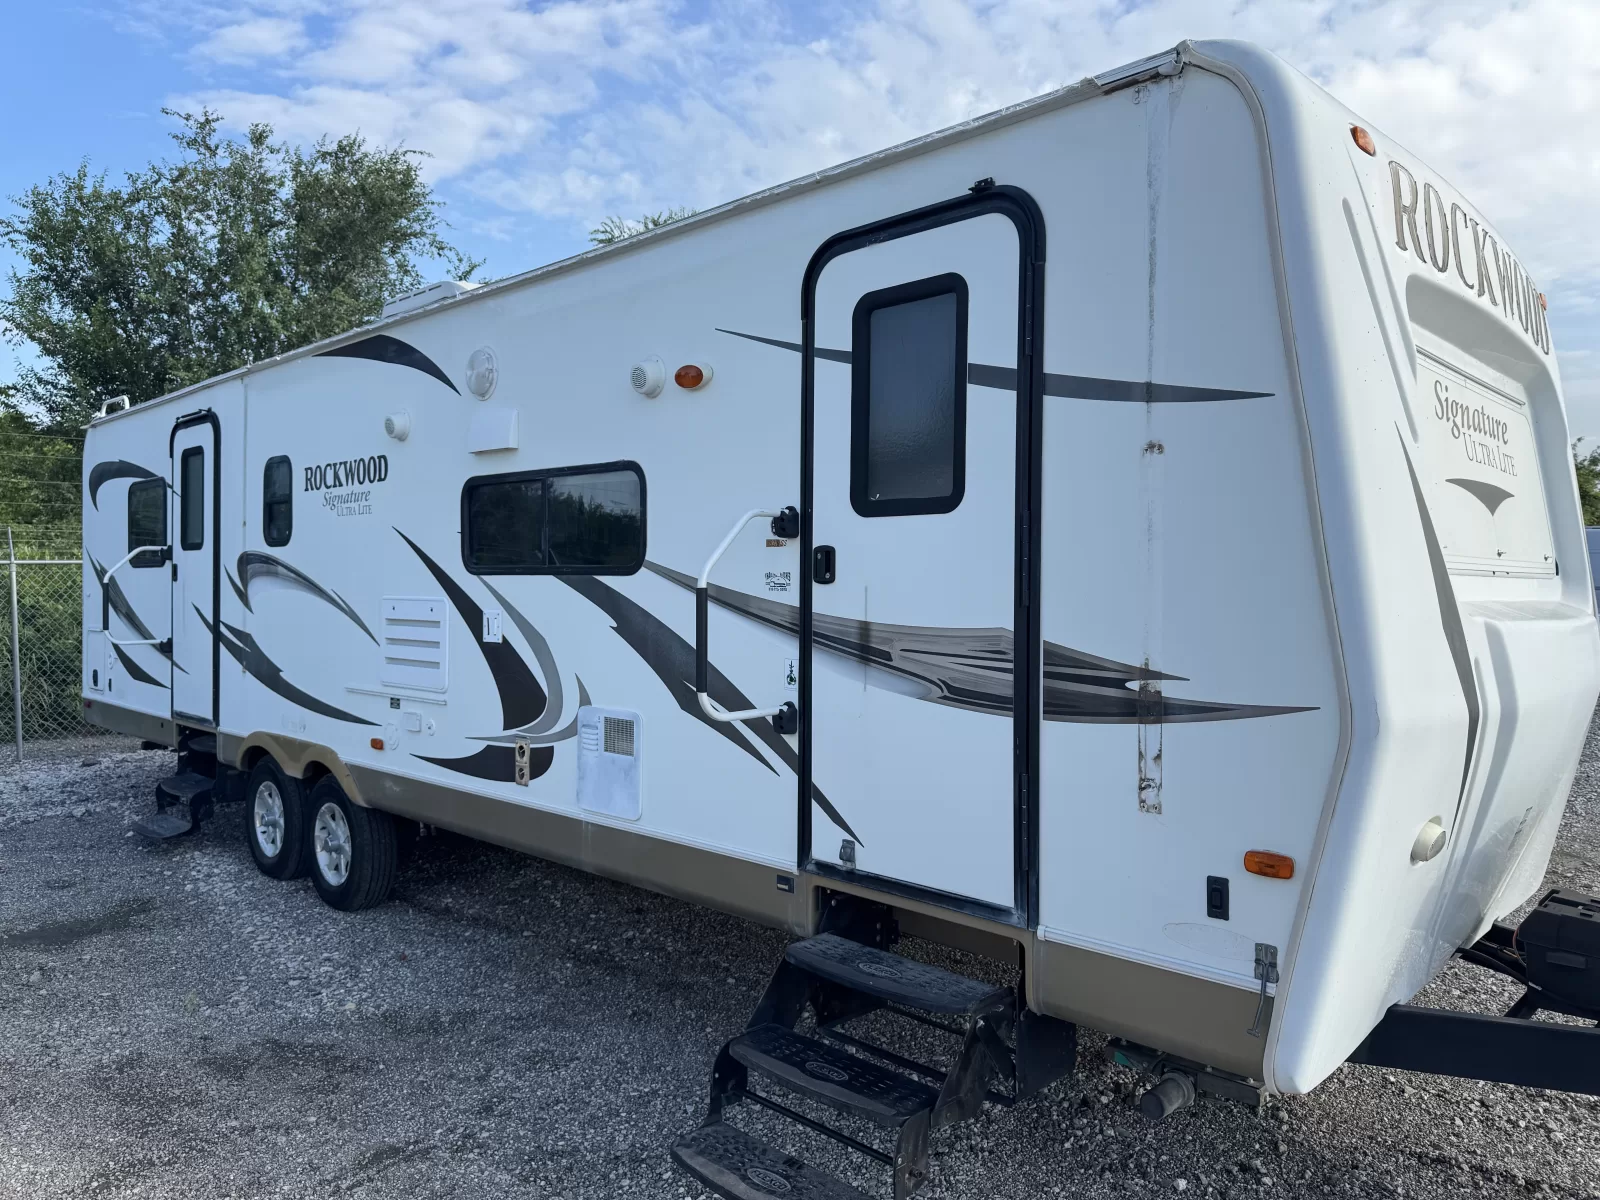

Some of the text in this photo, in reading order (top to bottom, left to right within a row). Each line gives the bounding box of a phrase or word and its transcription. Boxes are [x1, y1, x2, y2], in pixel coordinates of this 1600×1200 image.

[1388, 160, 1550, 356] ROCKWOOD
[1434, 380, 1508, 445] Signature
[304, 454, 389, 491] ROCKWOOD
[1463, 432, 1518, 477] ULTRA LITE
[322, 490, 371, 510] Signature
[336, 503, 373, 516] ULTRA LITE
[751, 1169, 788, 1191] FLEXCO
